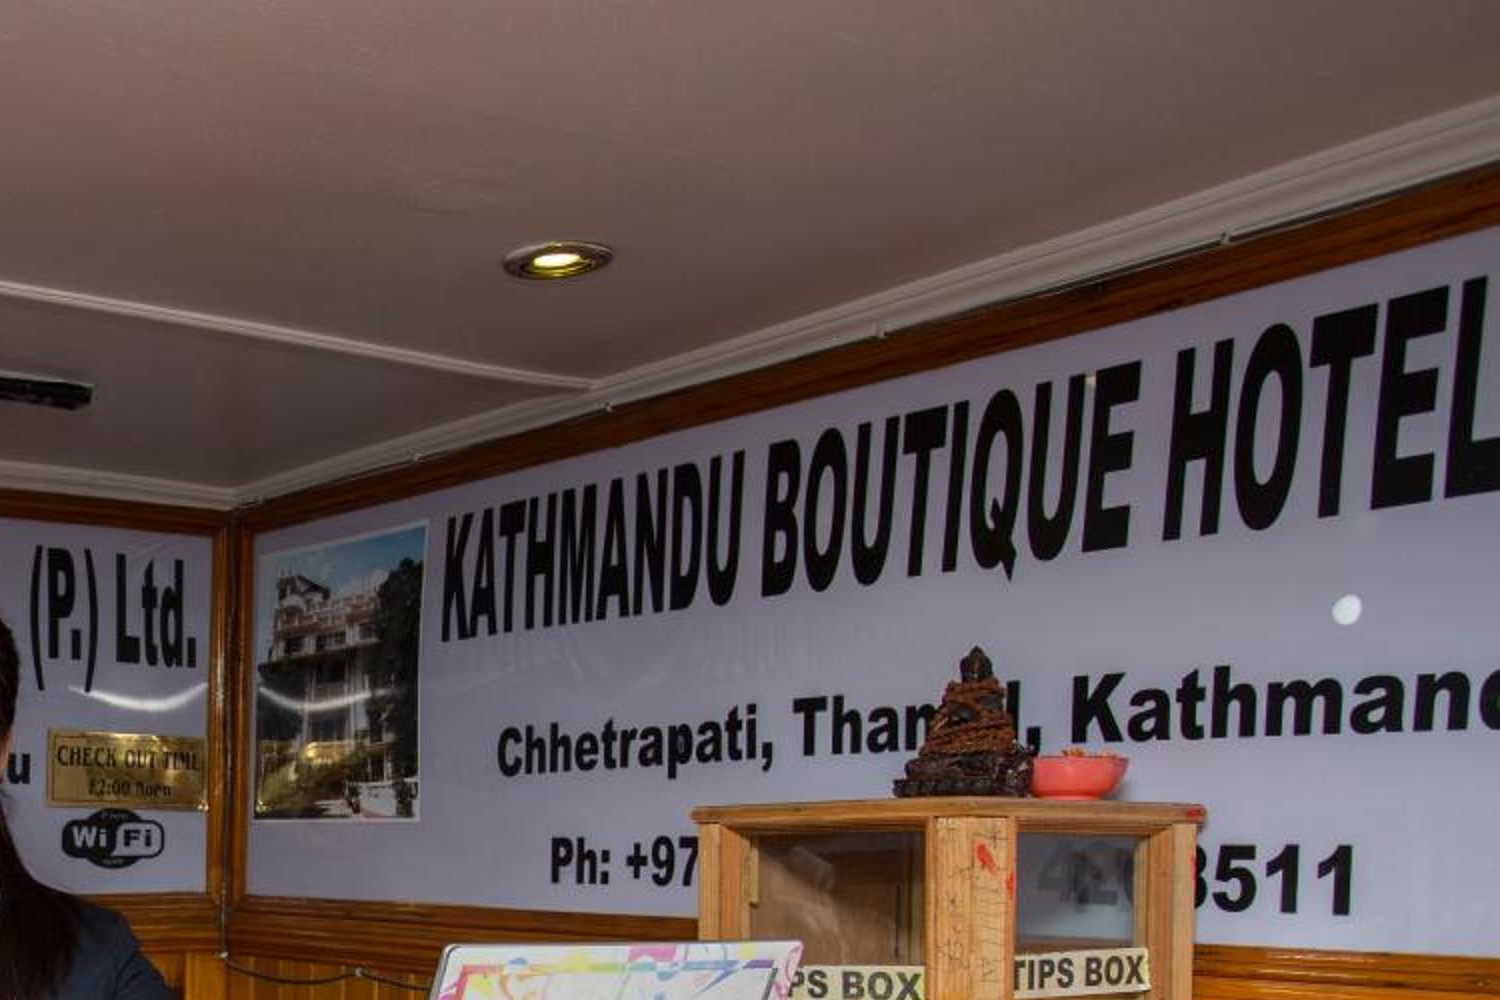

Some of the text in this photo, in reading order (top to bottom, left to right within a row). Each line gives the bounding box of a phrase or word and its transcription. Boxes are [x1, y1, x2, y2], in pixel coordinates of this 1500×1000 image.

[441, 275, 1500, 642] KATHMANDU BOUTIQUE HOTEL
[30, 545, 98, 692] (P.)
[116, 553, 197, 668] Ltd.
[57, 745, 117, 768] CHECK
[125, 749, 156, 769] OUT
[498, 703, 773, 779] Chhetrapati,
[550, 836, 609, 887] Ph:
[1085, 954, 1145, 987] BOX
